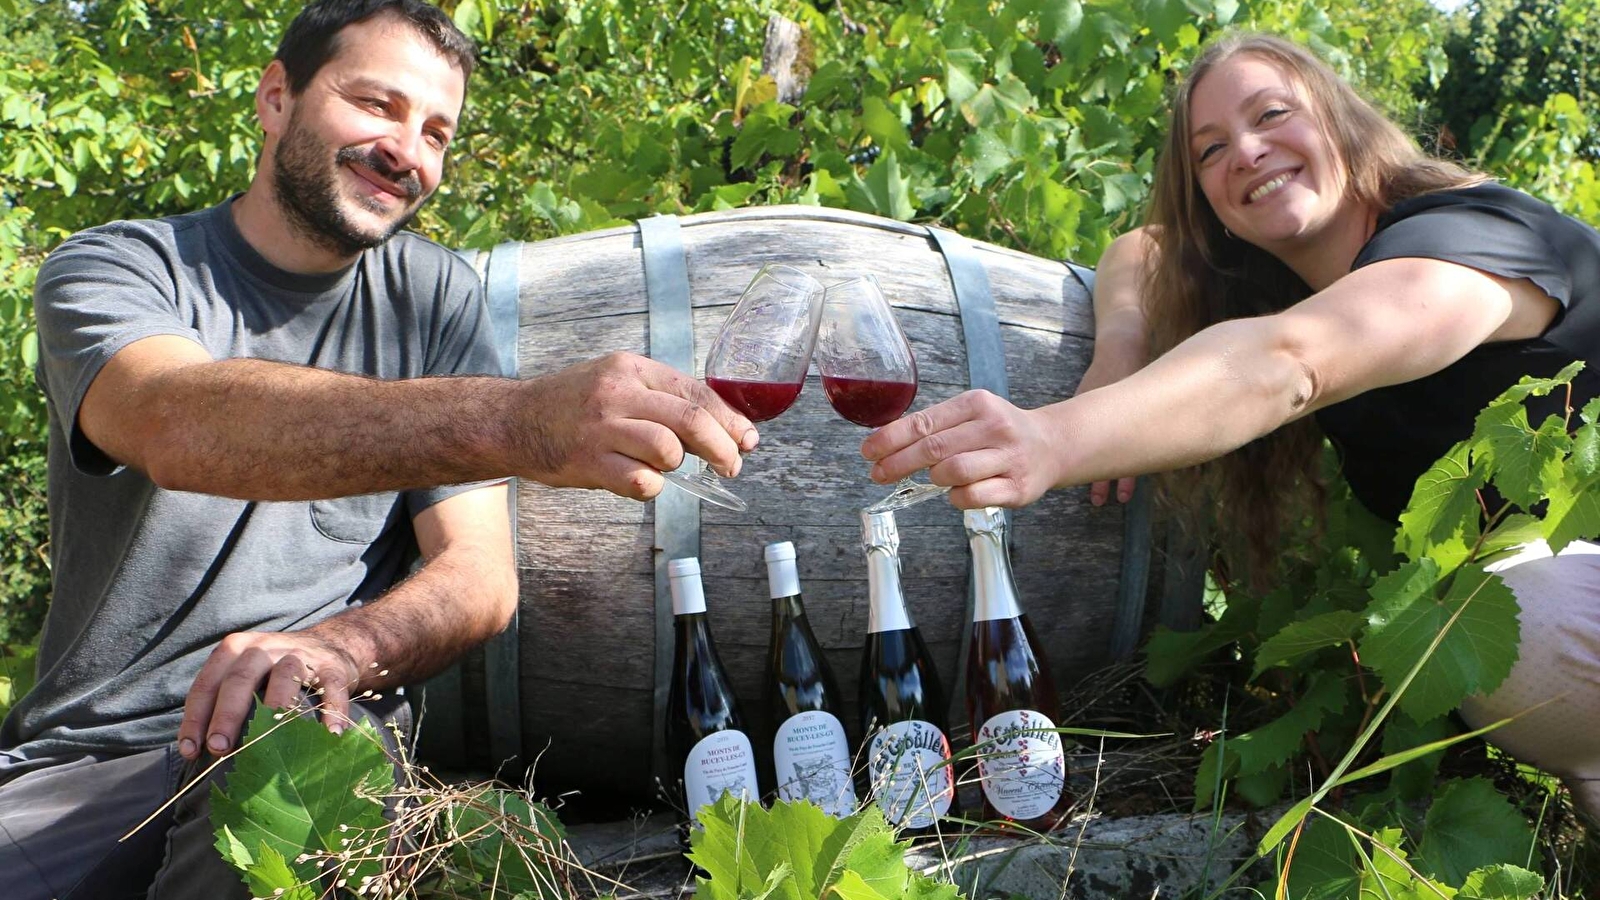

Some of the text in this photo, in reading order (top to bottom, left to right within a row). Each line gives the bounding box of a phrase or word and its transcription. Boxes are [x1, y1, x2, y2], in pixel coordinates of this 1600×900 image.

[787, 730, 834, 743] BUCEY-LES-GY
[793, 725, 818, 735] MONTS
[707, 744, 740, 757] MONTS DE
[701, 751, 746, 766] BUCEY-LES-GY
